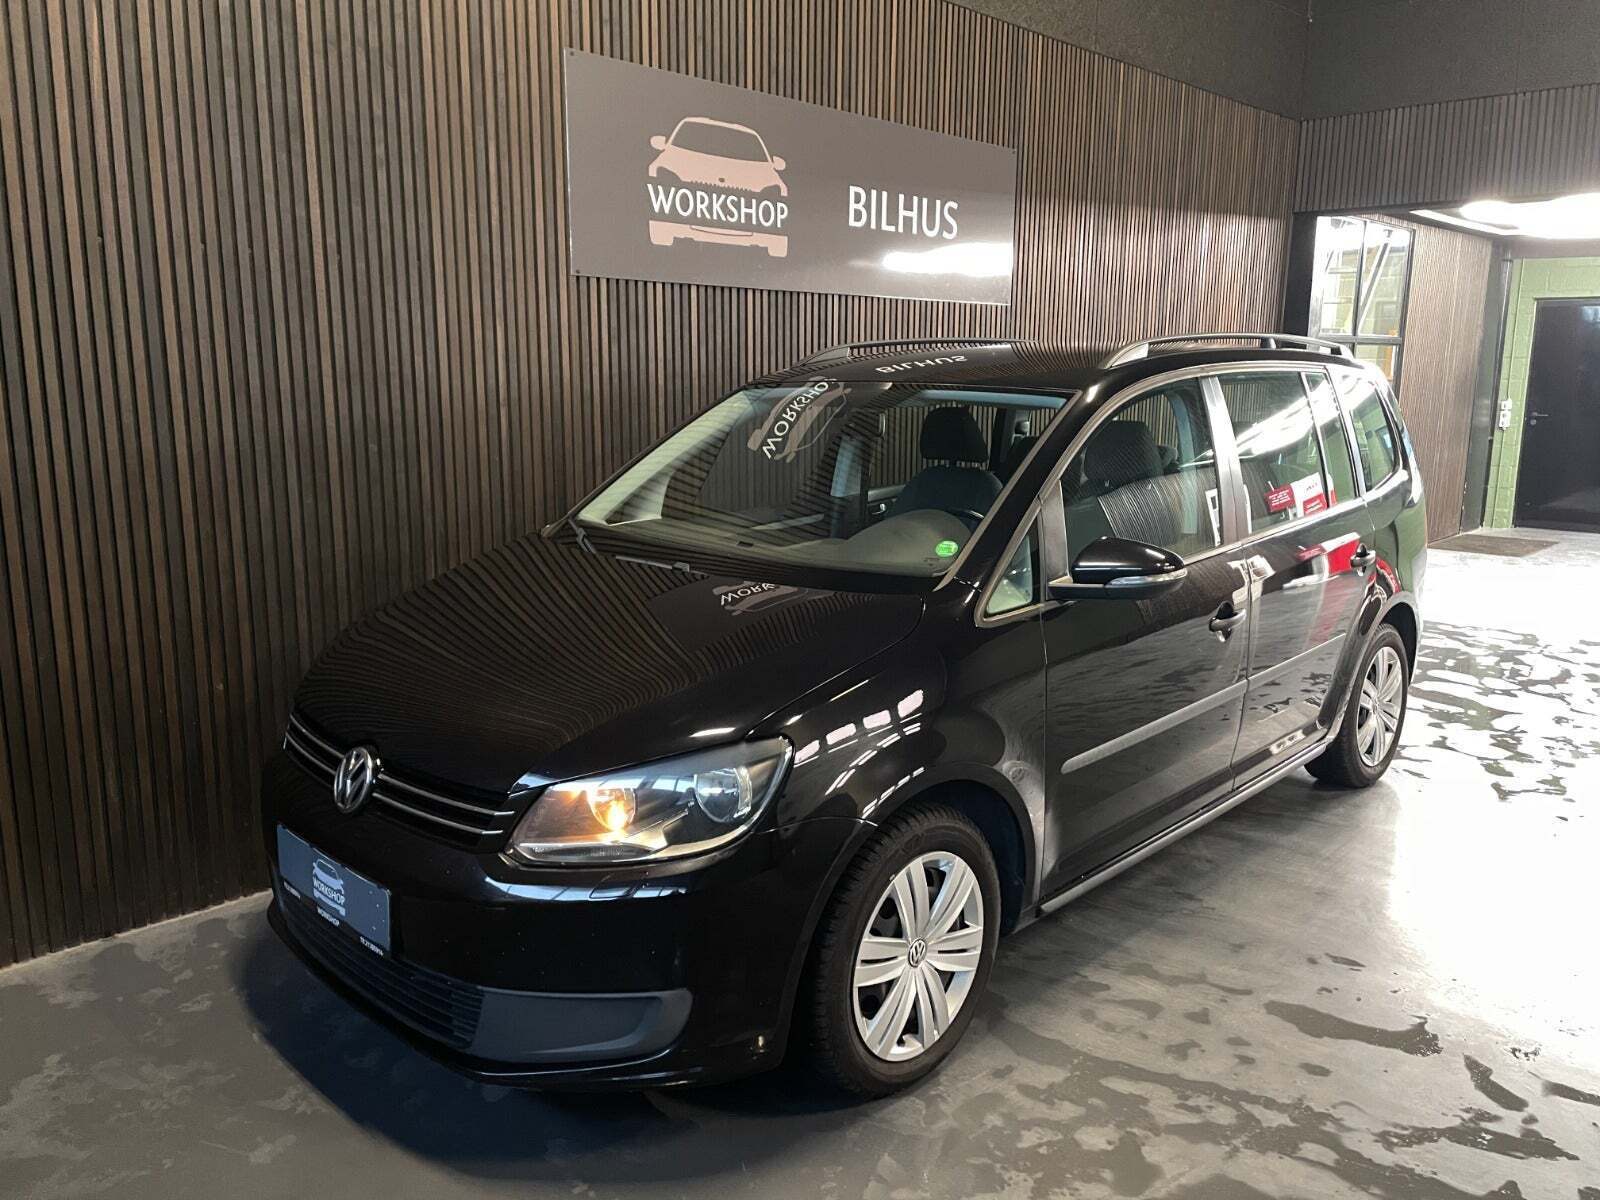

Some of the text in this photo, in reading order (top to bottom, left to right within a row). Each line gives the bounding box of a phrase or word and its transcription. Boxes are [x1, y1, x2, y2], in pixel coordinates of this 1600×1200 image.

[646, 183, 789, 228] WORKSHOP
[848, 185, 959, 240] BILHUS
[313, 876, 346, 906] WORKSHOP
